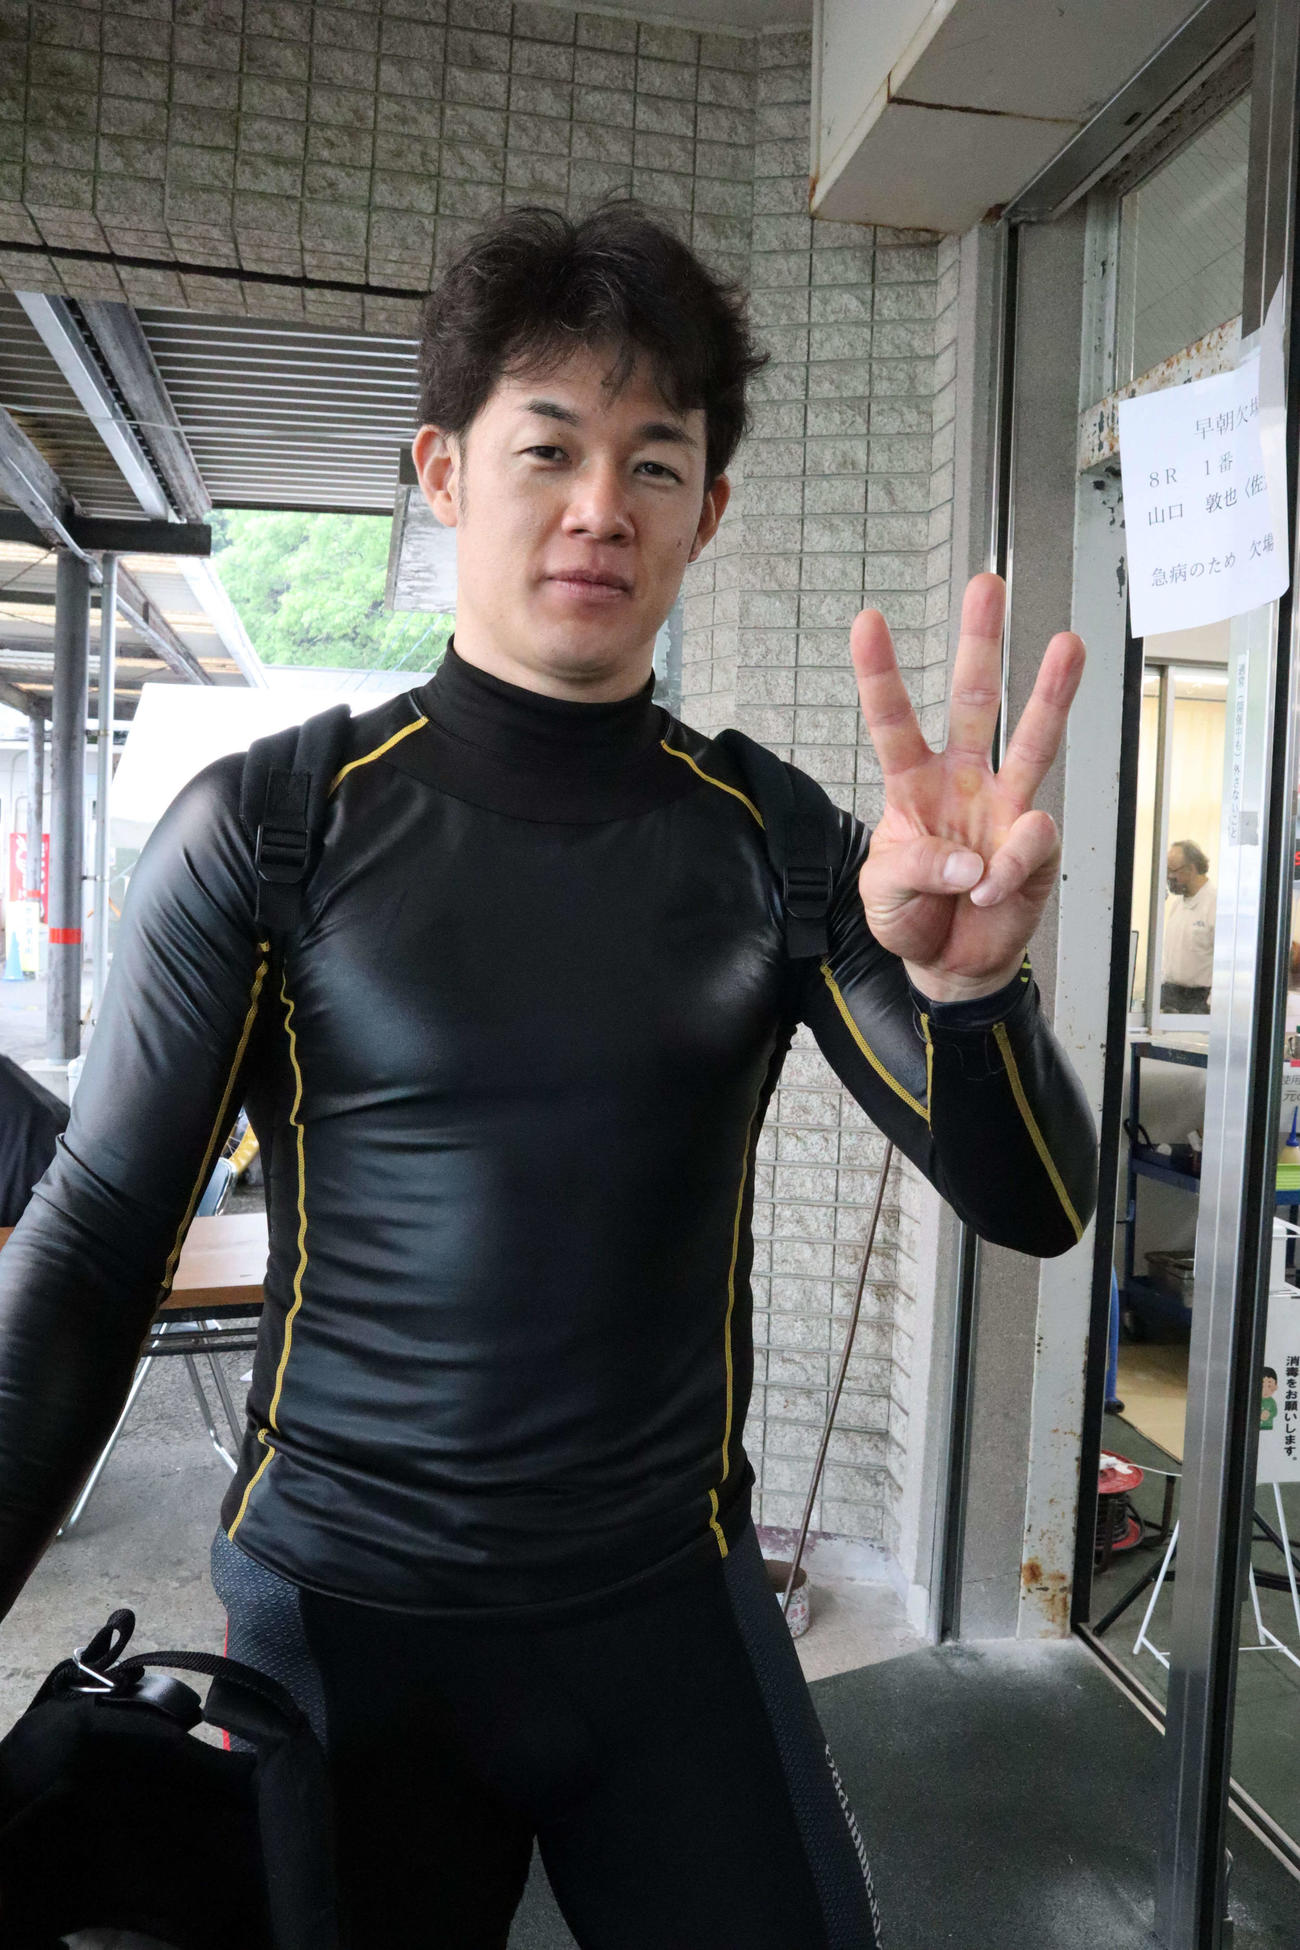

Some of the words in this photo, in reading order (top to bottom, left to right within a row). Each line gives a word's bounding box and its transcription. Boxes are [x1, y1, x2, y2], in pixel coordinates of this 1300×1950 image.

[1148, 503, 1184, 526] 山口
[1284, 1355, 1300, 1461] 消毒をお願いします。
